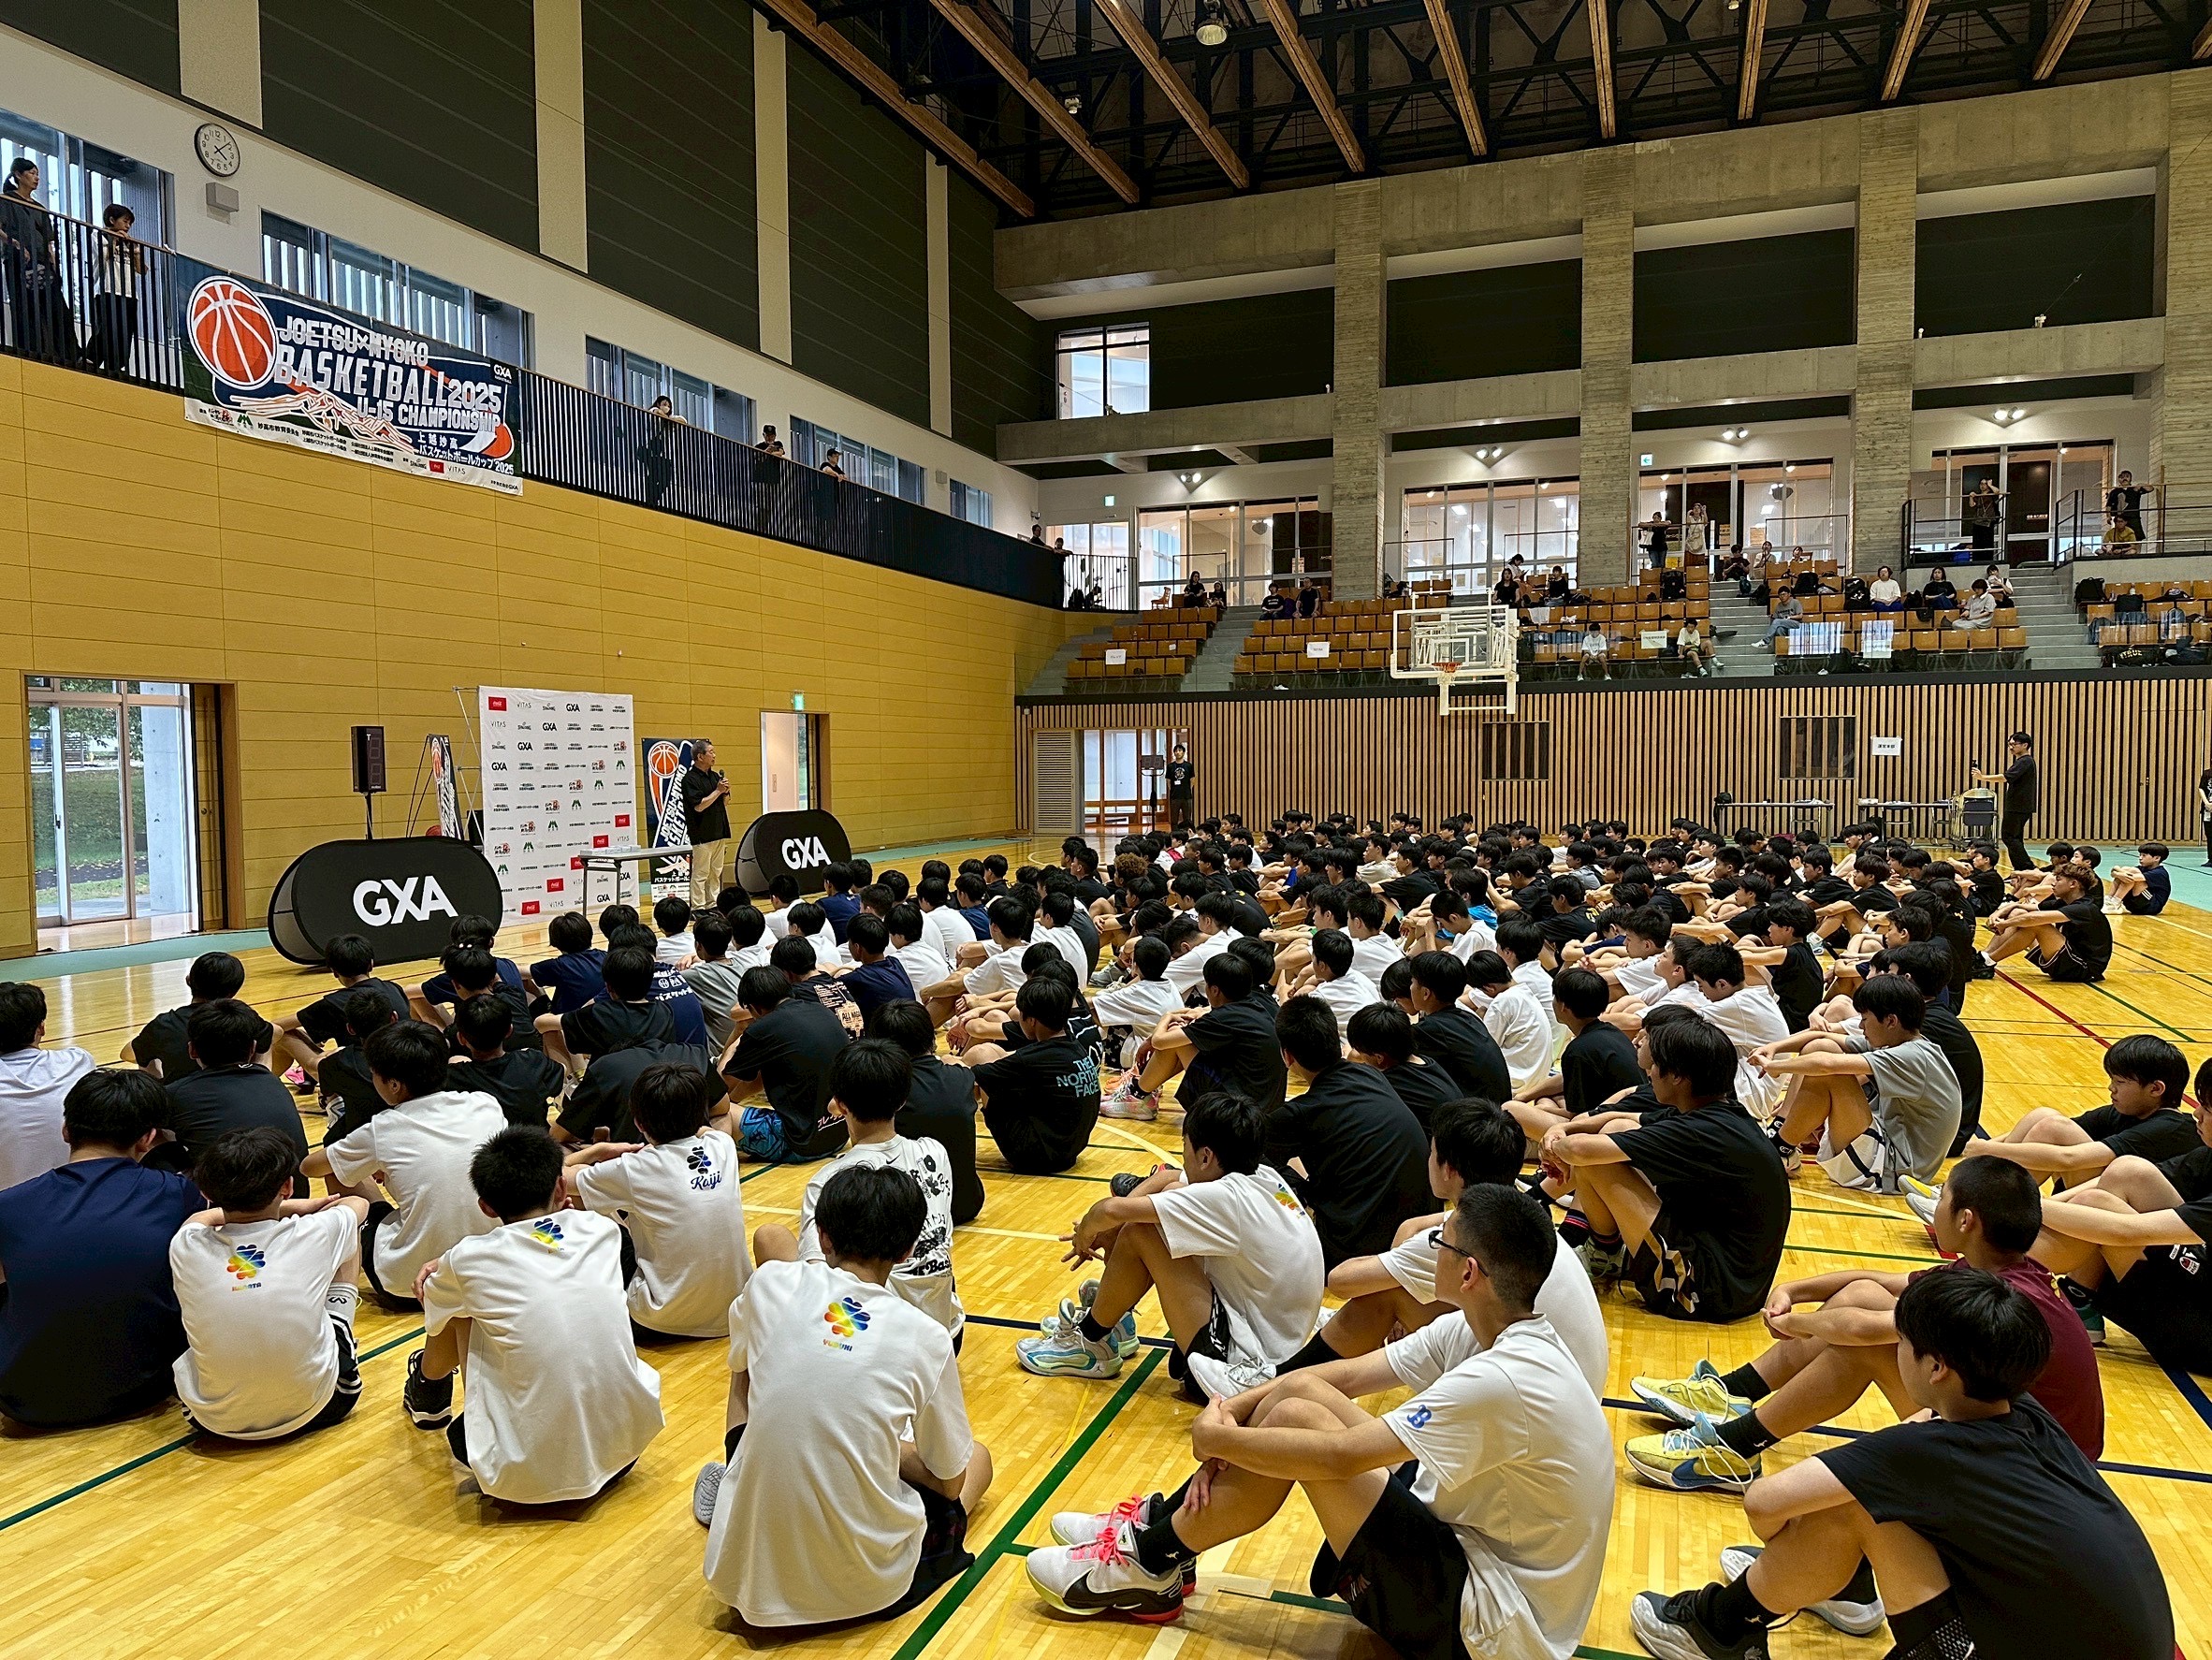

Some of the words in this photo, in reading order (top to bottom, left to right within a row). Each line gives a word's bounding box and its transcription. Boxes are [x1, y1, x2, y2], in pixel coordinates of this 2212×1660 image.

[493, 364, 512, 379] GXA
[357, 397, 394, 422] U-15
[398, 404, 501, 432] CHAMPIONSHIP
[417, 430, 458, 450] 上越妙高
[418, 444, 493, 469] バスケットボールカップ
[494, 460, 515, 475] 2025
[447, 464, 466, 474] VITAS
[565, 704, 580, 712] GXA
[542, 722, 557, 731] GXA
[517, 742, 533, 751] GXA
[491, 762, 507, 771] GXA
[781, 837, 832, 869] GXA
[353, 876, 458, 926] GXA
[596, 894, 610, 902] GXA
[1073, 1056, 1093, 1071] THE
[1056, 1067, 1098, 1086] NORTH
[1075, 1081, 1099, 1098] FACE
[691, 1171, 721, 1190] Kaiji
